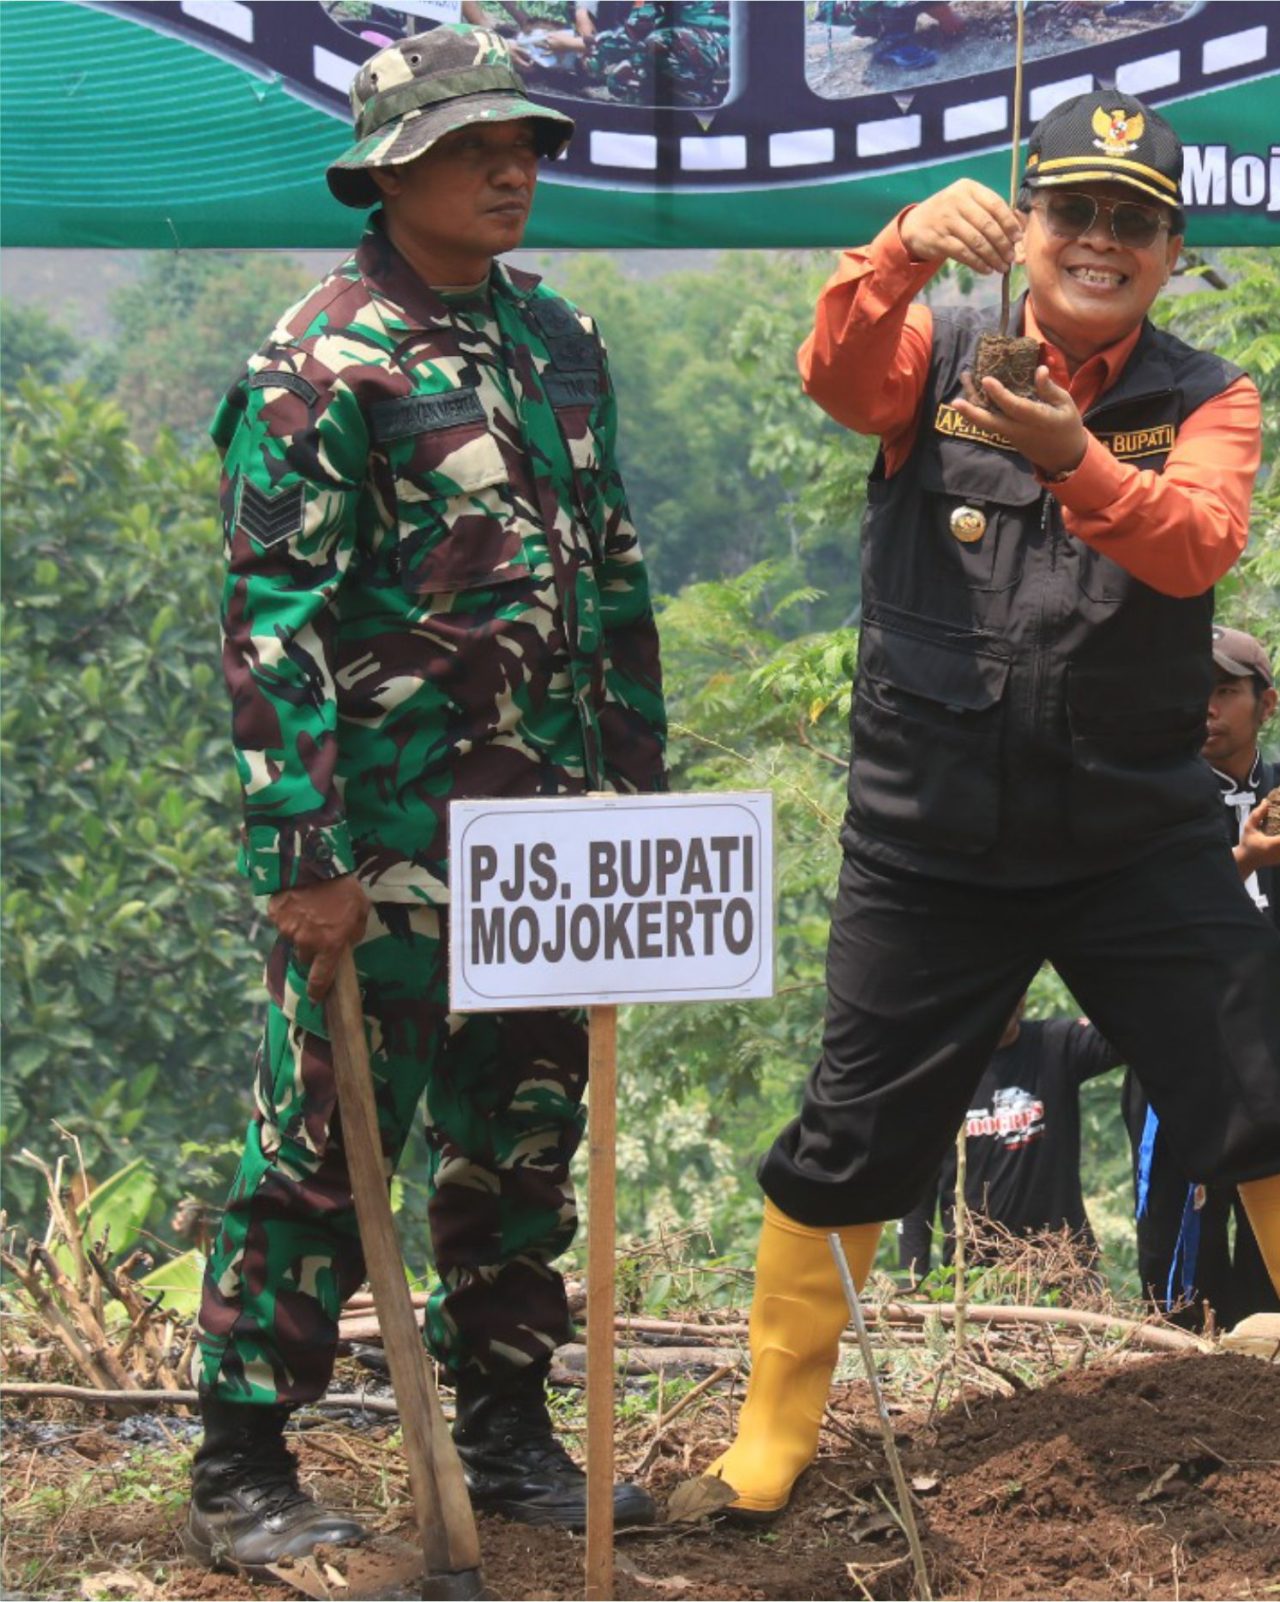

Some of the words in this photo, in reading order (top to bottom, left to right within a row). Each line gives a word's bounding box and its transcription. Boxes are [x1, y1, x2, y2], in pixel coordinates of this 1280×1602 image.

[1113, 427, 1171, 453] BUPATI
[470, 841, 571, 903] PJS.
[589, 835, 753, 899] BUPATI
[470, 896, 754, 965] MOJOKERTO
